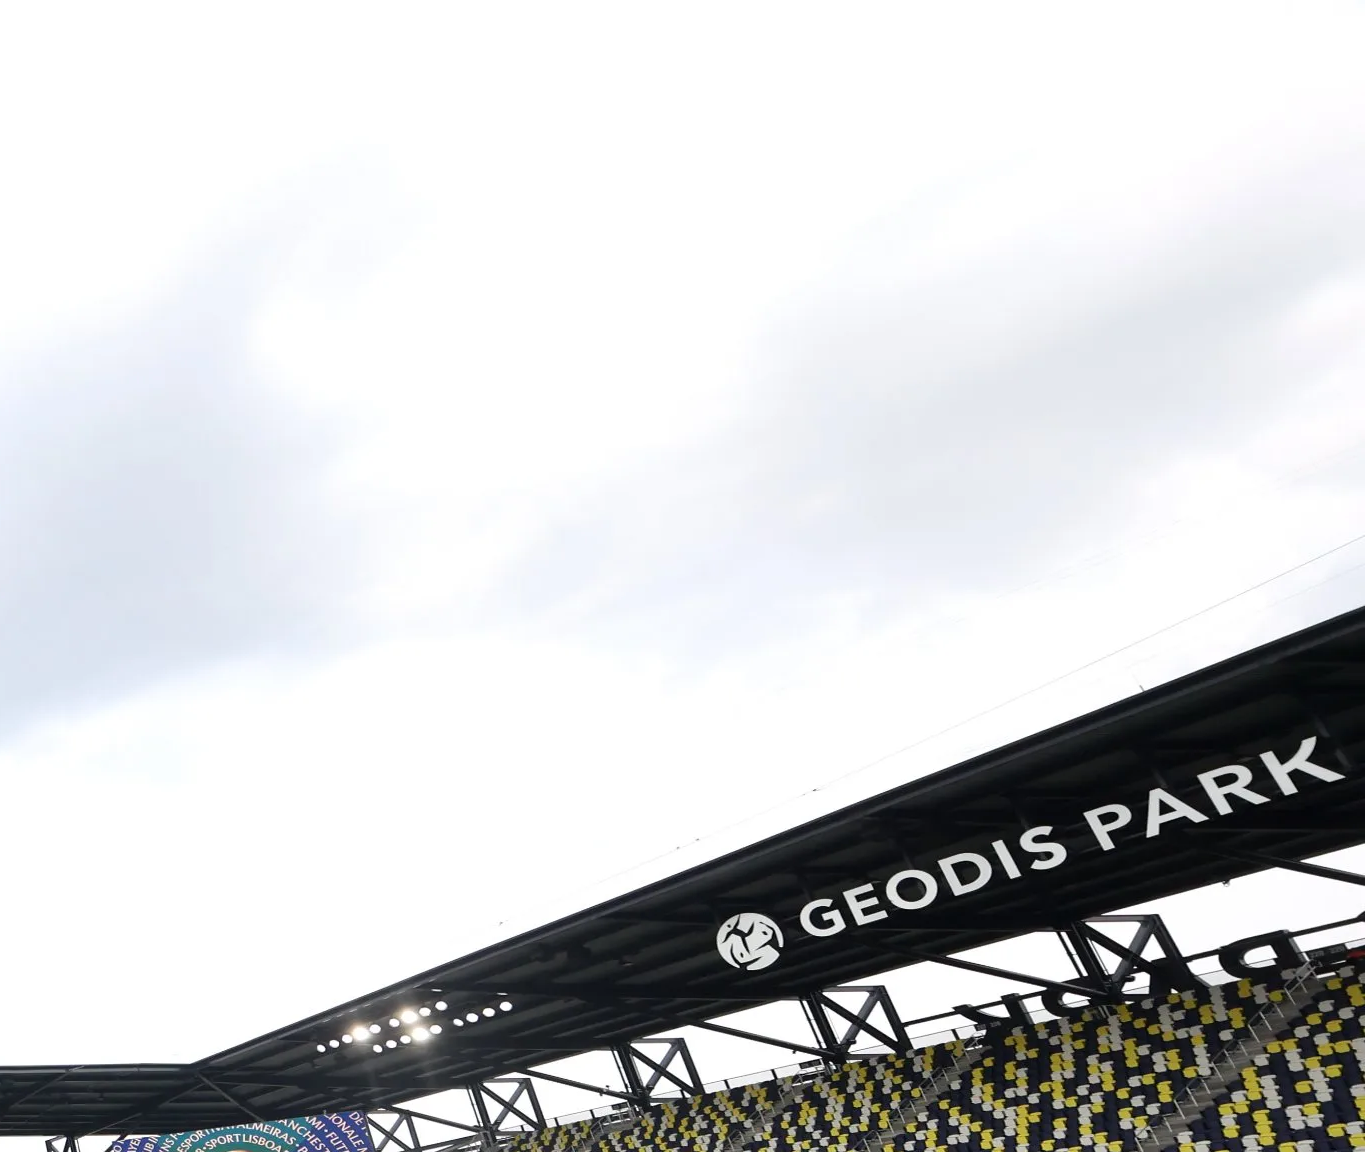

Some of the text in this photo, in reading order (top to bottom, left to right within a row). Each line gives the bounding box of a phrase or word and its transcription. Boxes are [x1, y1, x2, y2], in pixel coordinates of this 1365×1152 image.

[799, 736, 1346, 938] GEODIS PARK
[205, 1134, 242, 1150] SPORT
